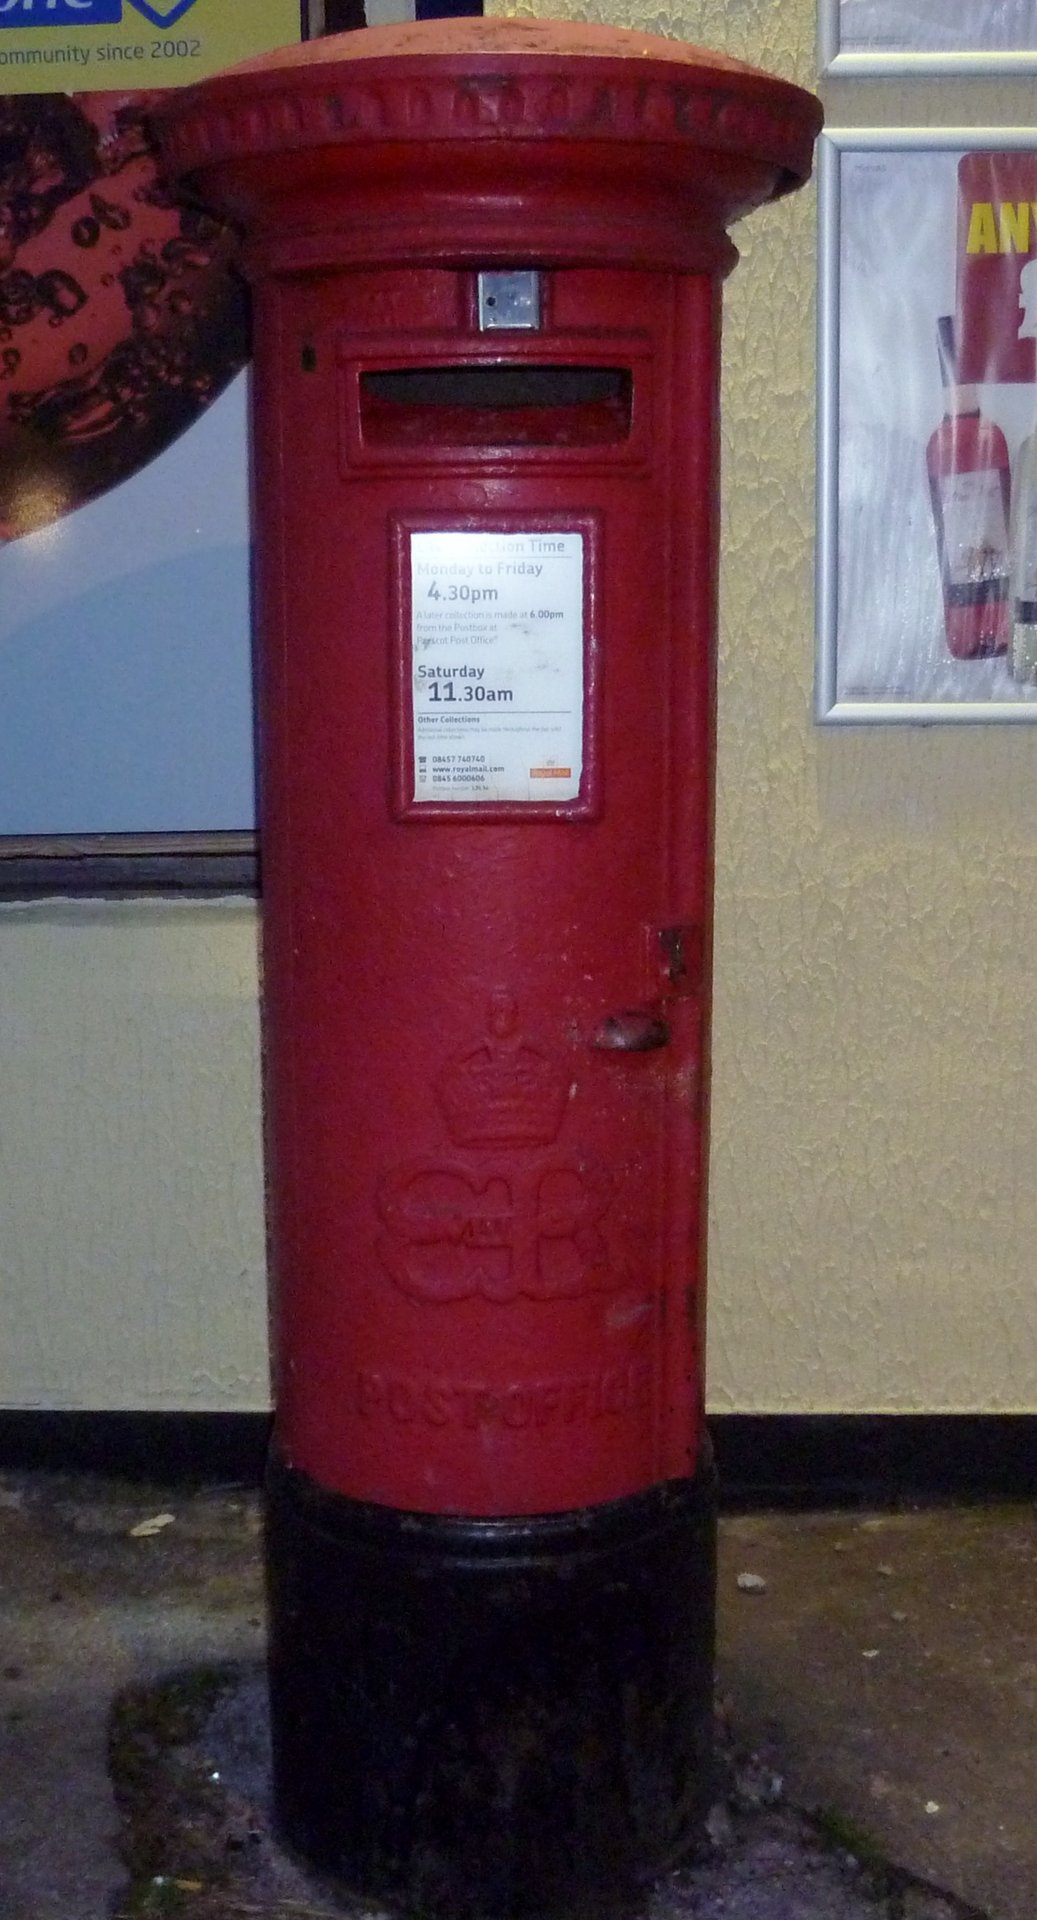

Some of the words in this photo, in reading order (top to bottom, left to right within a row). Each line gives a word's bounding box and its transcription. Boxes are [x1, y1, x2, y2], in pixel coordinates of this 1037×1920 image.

[96, 43, 144, 61] since
[151, 40, 201, 58] 2002
[966, 202, 1037, 254] AN
[529, 539, 565, 553] Time
[417, 562, 473, 578] Monday
[479, 563, 493, 576] to
[497, 561, 544, 578] Friday
[427, 580, 499, 604] 4.30pm
[494, 610, 518, 620] made
[418, 665, 485, 680] Saturday
[428, 681, 514, 702] 11.30am
[417, 716, 439, 724] Other
[440, 715, 480, 724] Collections
[432, 765, 505, 773] www.royalmail.com
